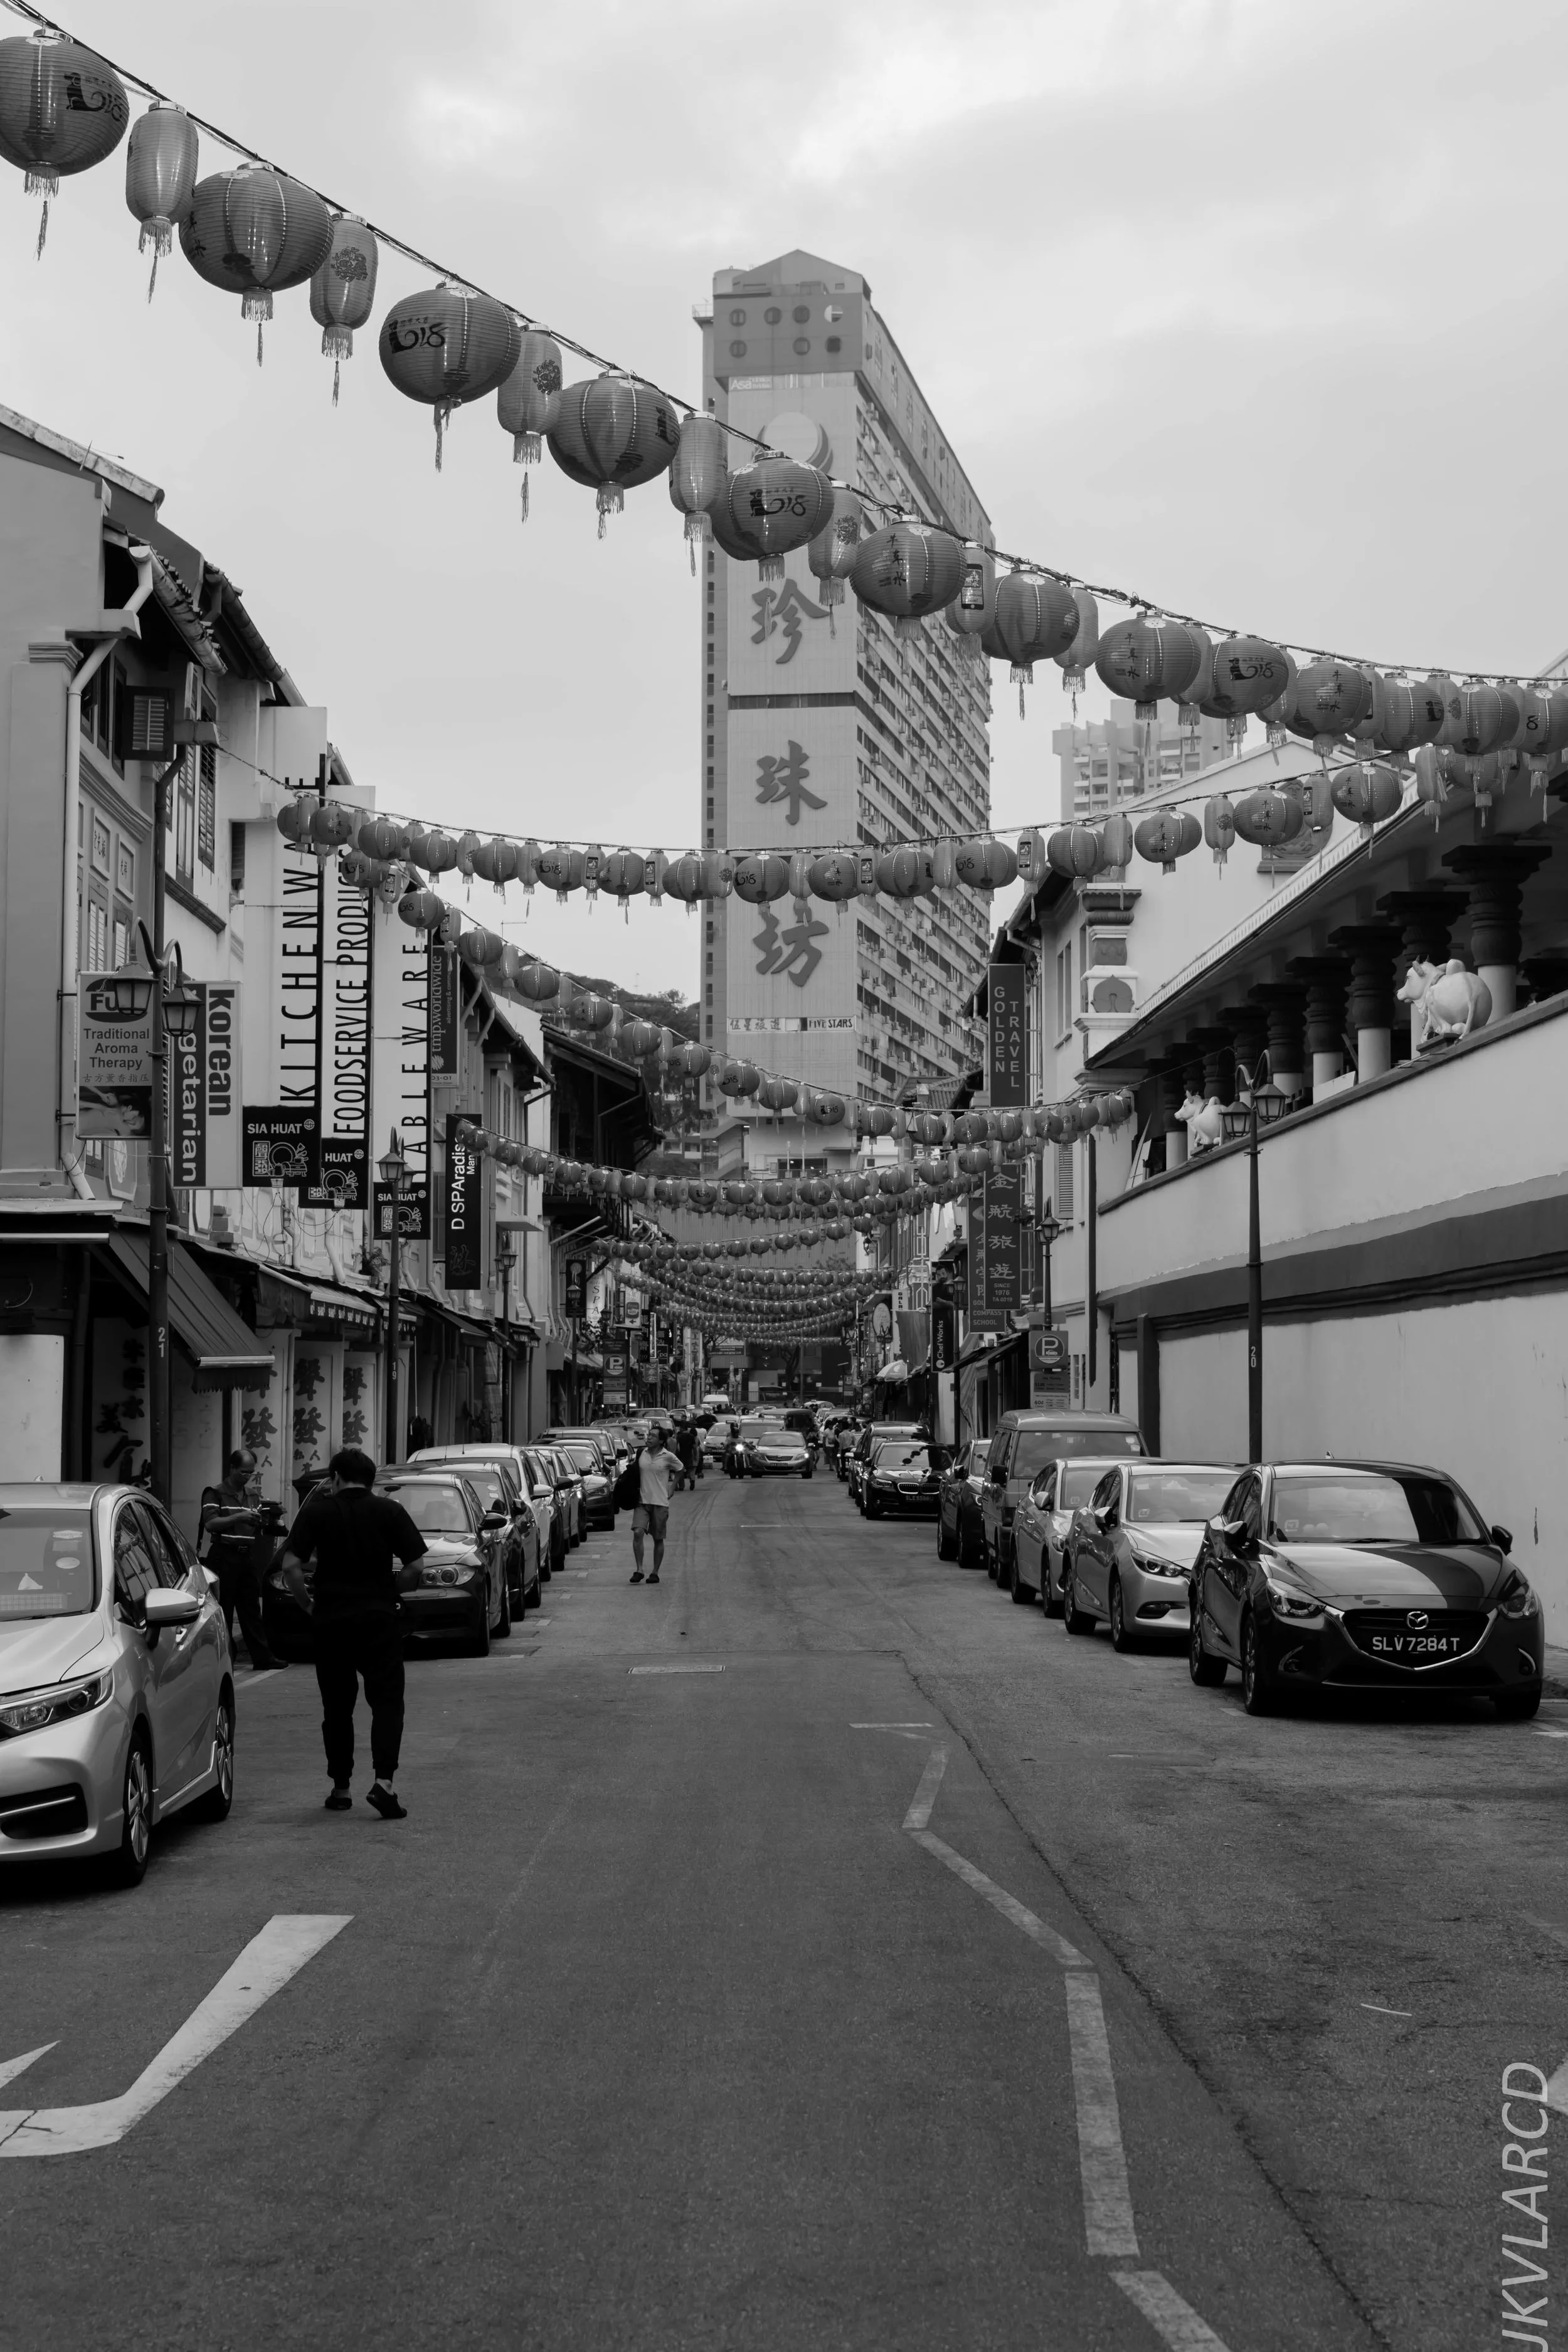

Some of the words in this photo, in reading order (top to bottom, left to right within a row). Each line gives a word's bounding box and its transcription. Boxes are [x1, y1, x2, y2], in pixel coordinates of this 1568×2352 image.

[731, 379, 752, 389] Asa
[280, 776, 319, 1101] KITCHENWE
[808, 1019, 827, 1029] FIVE
[828, 1018, 853, 1029] STARS
[83, 1029, 150, 1039] Traditional
[994, 986, 1005, 1073] GOLDEN
[1010, 1001, 1020, 1088] TRAVEL
[95, 1042, 138, 1054] Aroma
[208, 989, 235, 1116] korean
[89, 1057, 143, 1070] Therapy
[333, 979, 368, 1134] FOODSERVICE
[178, 989, 201, 1182] getarian
[247, 1123, 270, 1134] SIA
[271, 1123, 302, 1134] HUAT
[325, 1153, 353, 1163] HUAT
[451, 1137, 466, 1213] SPAradis
[378, 1193, 392, 1202] SIA
[451, 1217, 465, 1230] D
[1042, 1337, 1059, 1356] P
[1250, 1346, 1256, 1368] 20
[392, 1362, 397, 1380] 19
